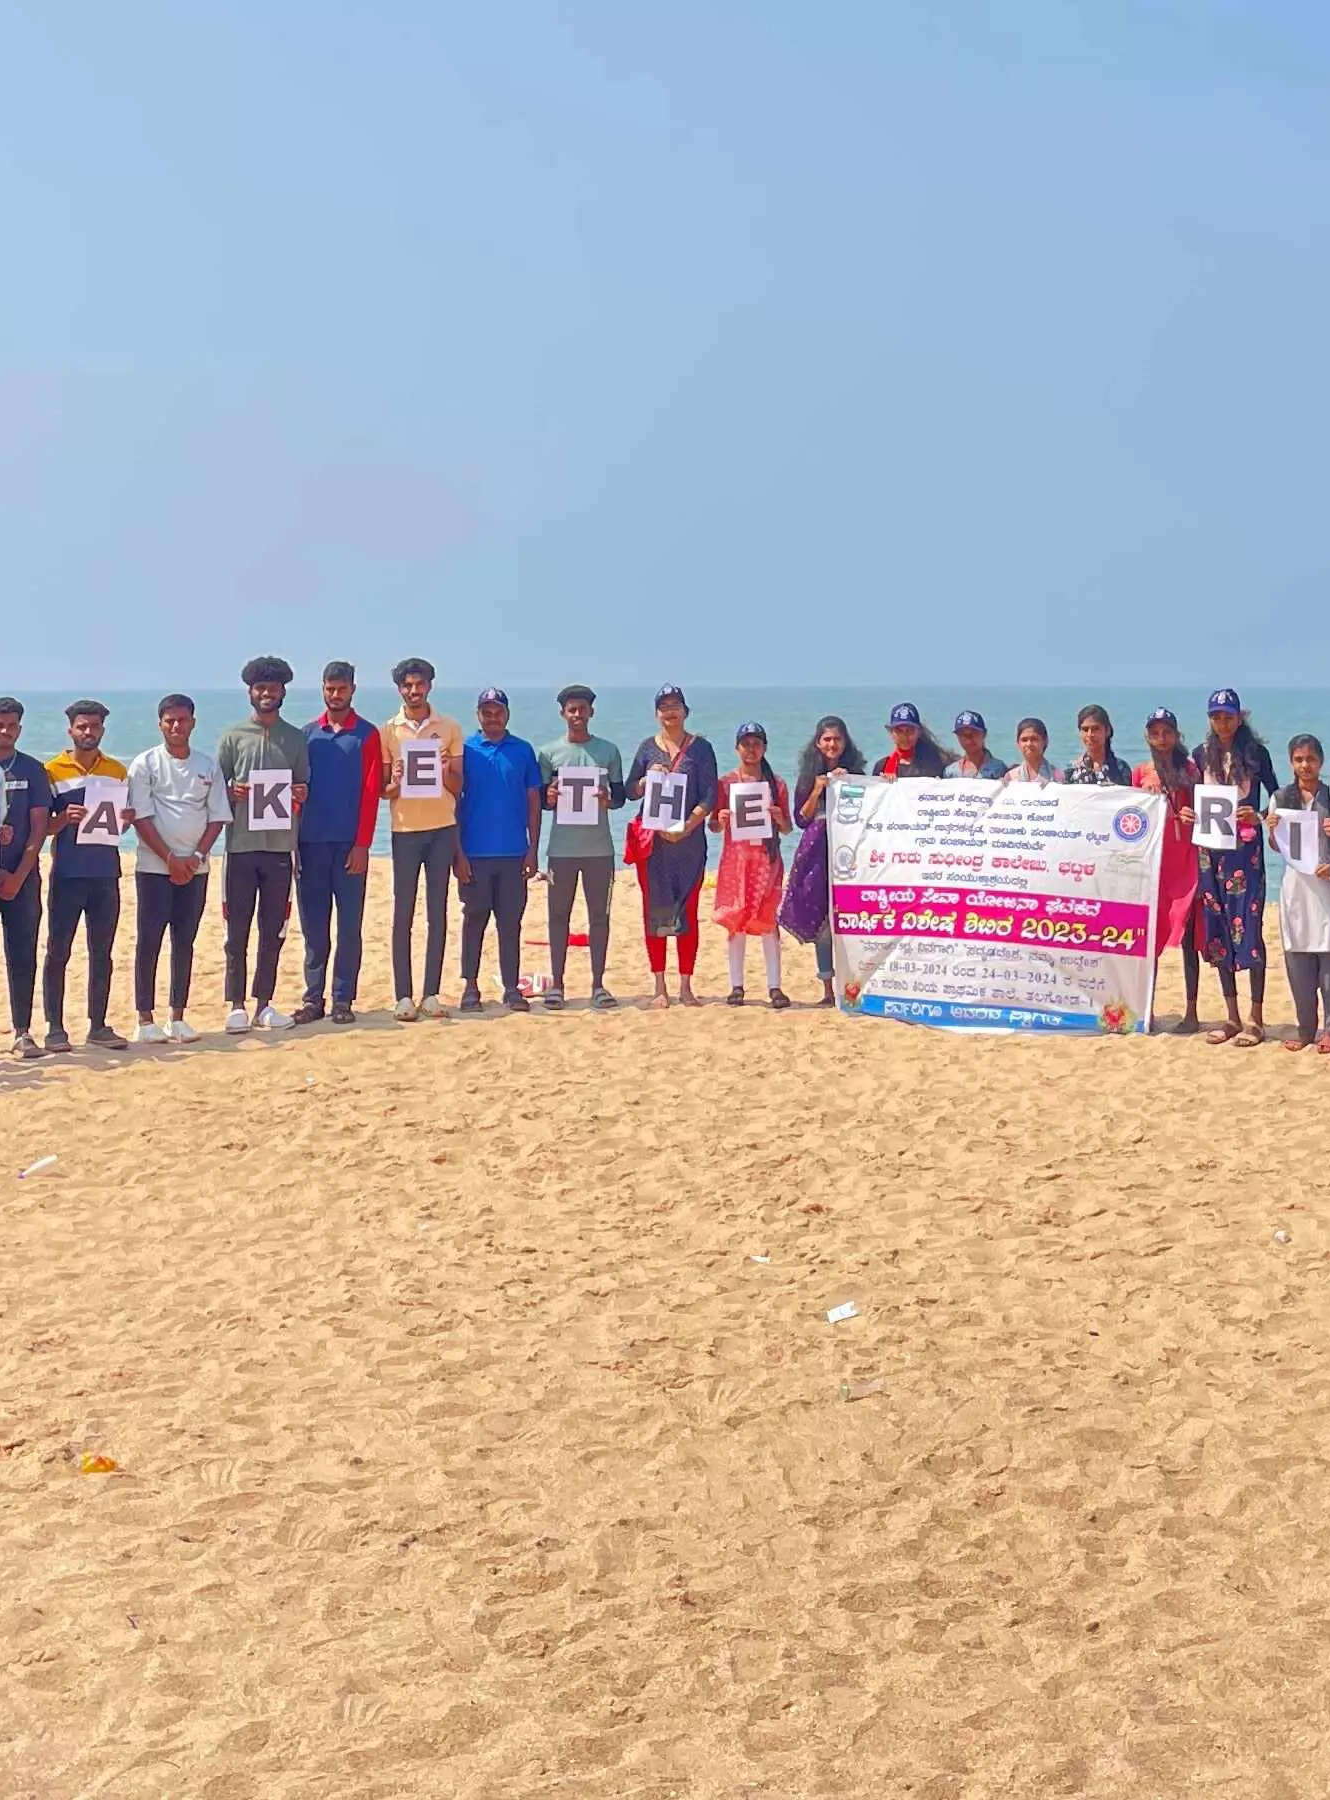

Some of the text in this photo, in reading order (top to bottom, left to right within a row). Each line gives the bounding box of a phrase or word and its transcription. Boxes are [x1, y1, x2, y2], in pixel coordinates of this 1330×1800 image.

[406, 750, 437, 786] E
[252, 782, 290, 820] K
[561, 777, 595, 813] T
[649, 782, 684, 821] H
[735, 793, 766, 829] E
[81, 801, 120, 837] A
[1200, 796, 1235, 838] R
[1289, 821, 1302, 861] I
[870, 849, 886, 868] ಶ್ರೀ
[892, 851, 921, 864] ಗುರು
[928, 851, 984, 872] ಸುಧೀಂದ್ರ
[1058, 860, 1096, 883] ಭಟ್ಕಳ
[860, 888, 1102, 917] ರಾಷ್ಟ್ರೀಯ ಸೇವಾ ಯೋಜನಾ ಘಟಕದ
[901, 908, 958, 936] ವಿಶೇಷ
[963, 912, 1015, 937] ಶಿಬಿರ
[981, 967, 1058, 985] 24-03-2024
